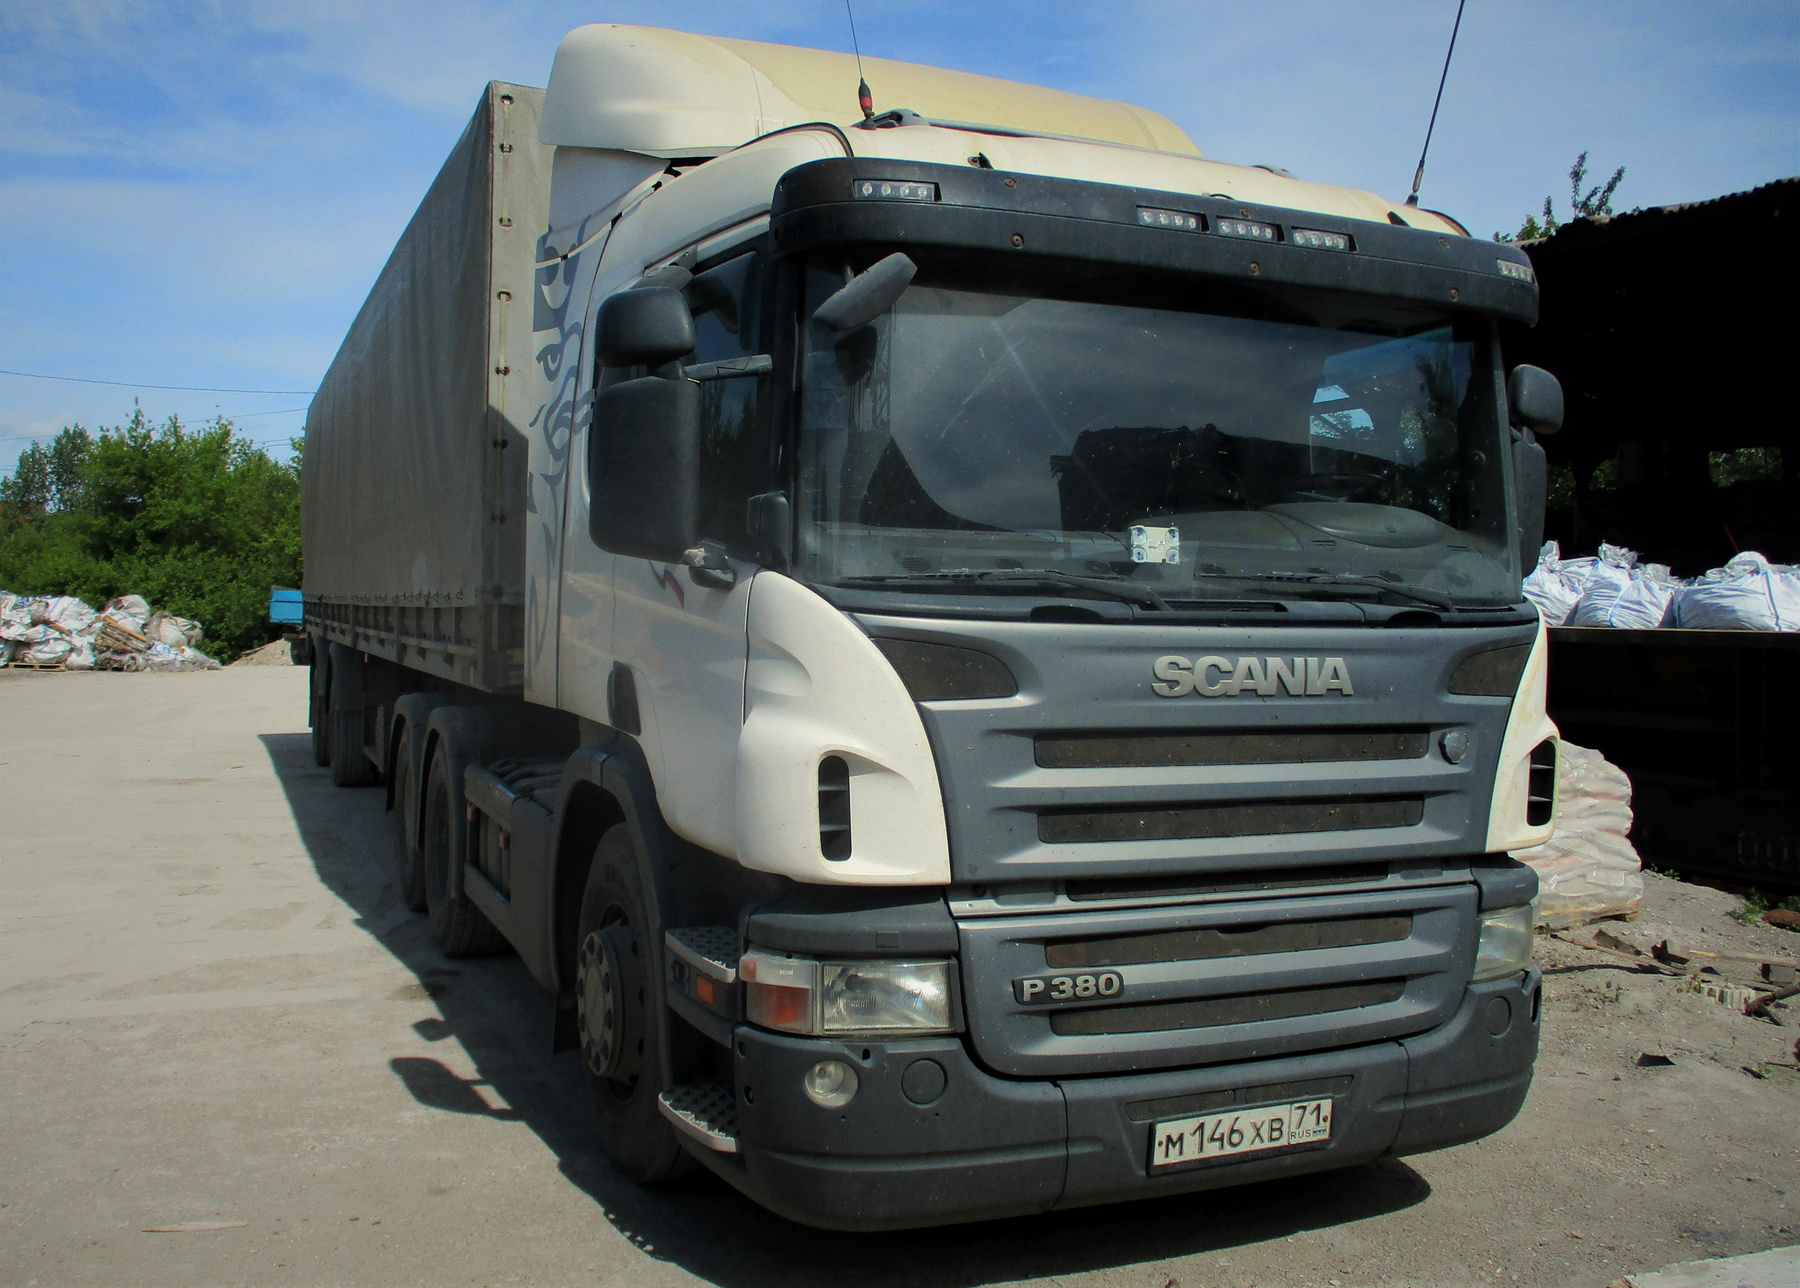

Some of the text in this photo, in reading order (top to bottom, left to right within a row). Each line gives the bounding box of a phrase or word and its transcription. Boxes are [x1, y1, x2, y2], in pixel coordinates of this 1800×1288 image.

[1152, 655, 1354, 697] SCANIA
[1022, 973, 1120, 1002] P 380
[1294, 1102, 1321, 1129] 71
[1290, 1129, 1312, 1140] RUS
